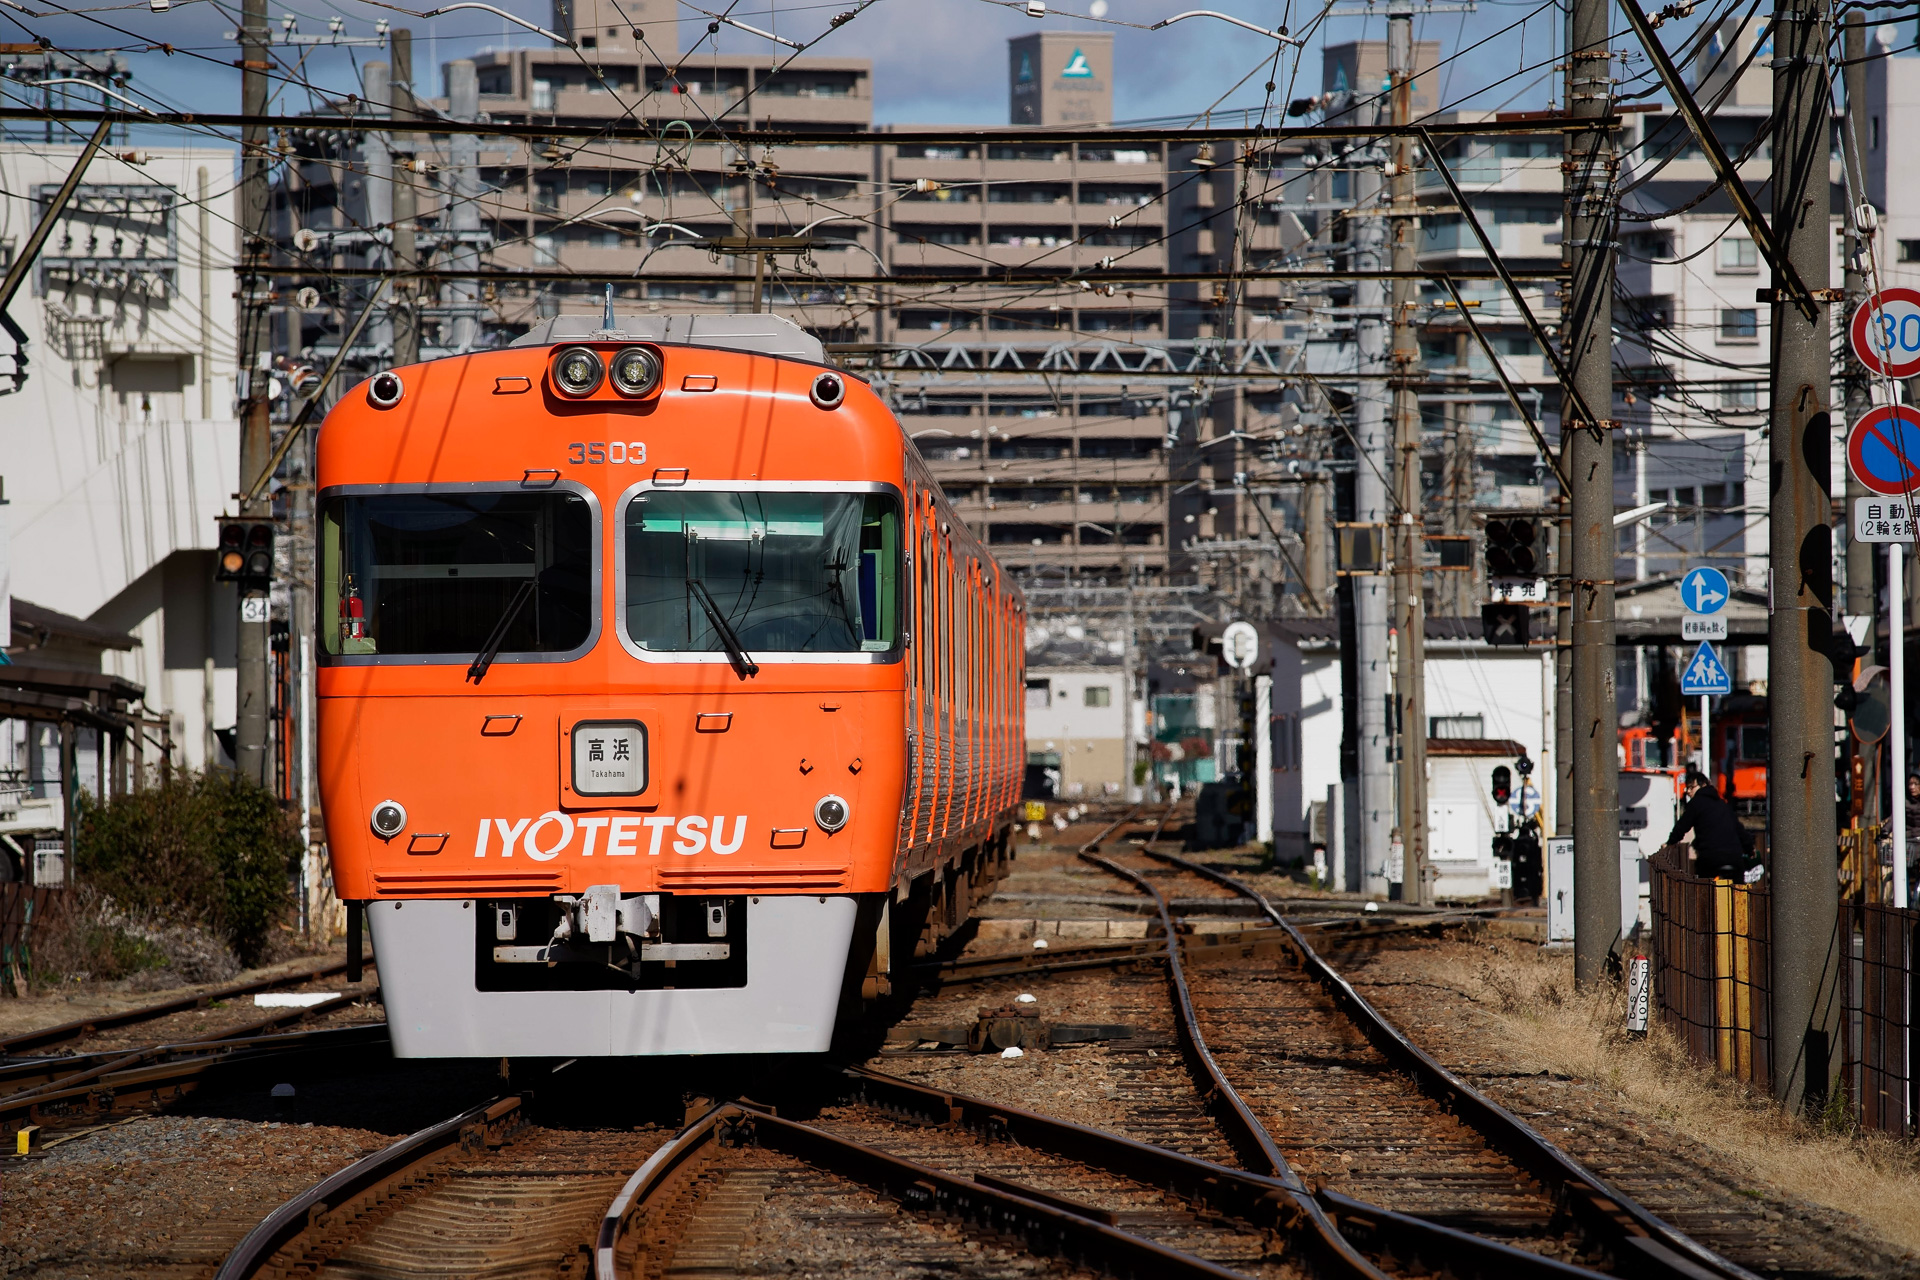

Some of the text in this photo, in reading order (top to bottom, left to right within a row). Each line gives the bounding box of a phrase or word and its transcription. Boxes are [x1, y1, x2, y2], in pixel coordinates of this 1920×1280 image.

[1874, 313, 1920, 352] 30
[568, 441, 647, 465] 3503
[1500, 582, 1536, 597] 特発
[246, 601, 267, 619] 34
[588, 738, 630, 762] 高浜
[591, 770, 625, 778] Takahama
[474, 811, 748, 861] IYOTETSU
